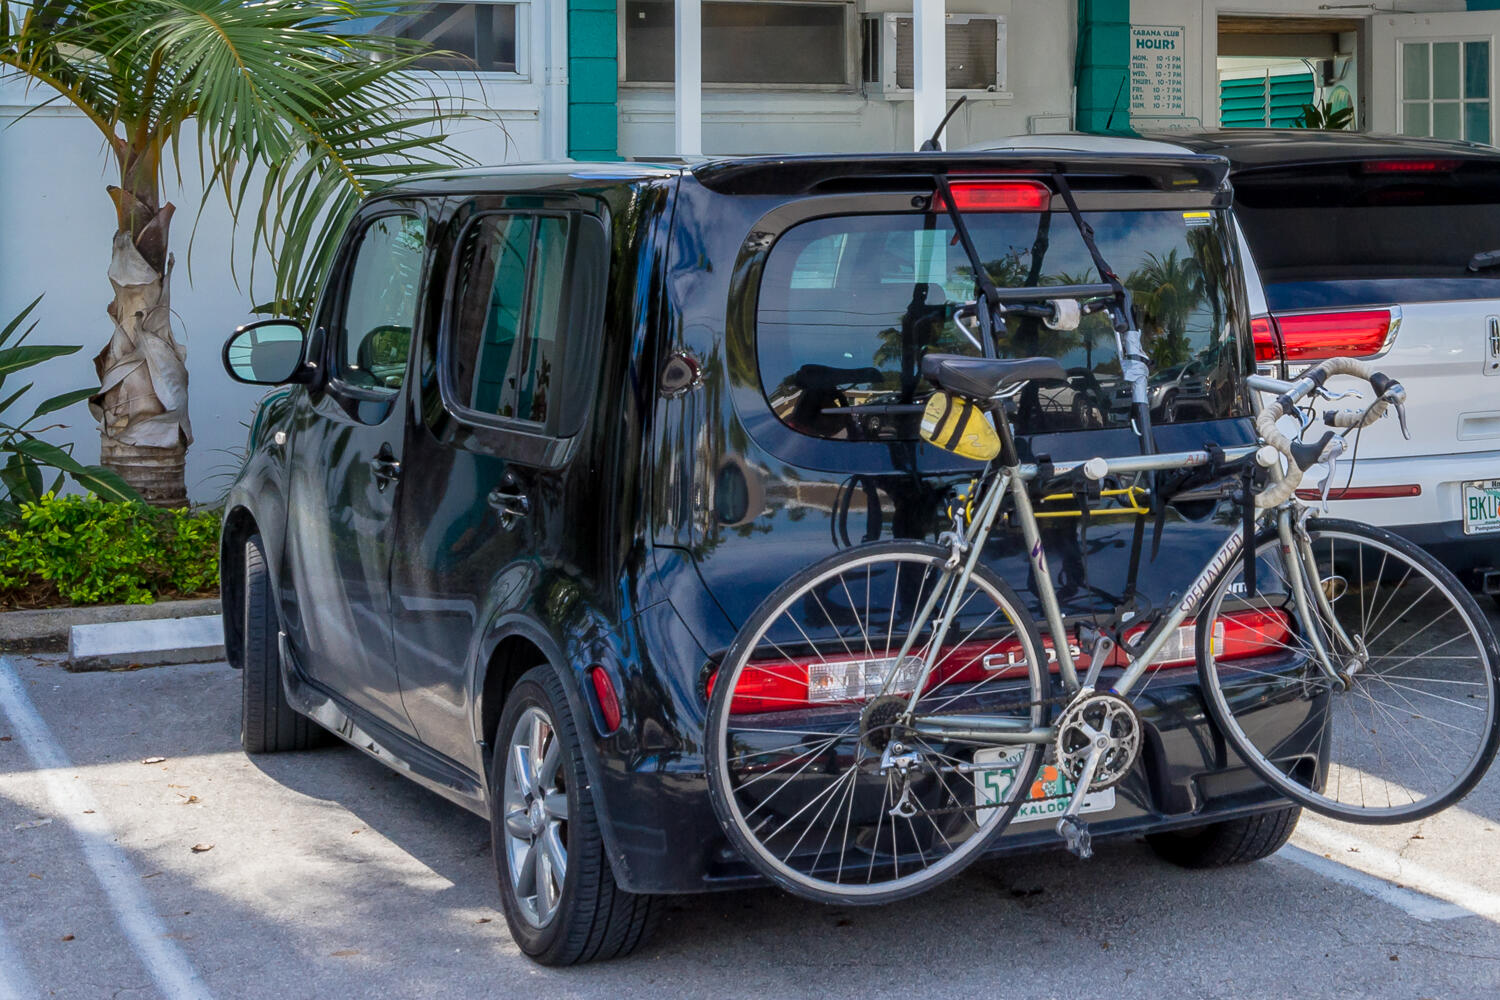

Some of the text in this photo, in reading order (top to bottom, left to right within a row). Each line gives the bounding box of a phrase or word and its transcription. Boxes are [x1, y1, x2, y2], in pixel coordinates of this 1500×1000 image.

[1136, 39, 1175, 50] HOURS
[1469, 496, 1497, 520] BKU
[1180, 533, 1244, 612] SPECIALIZED
